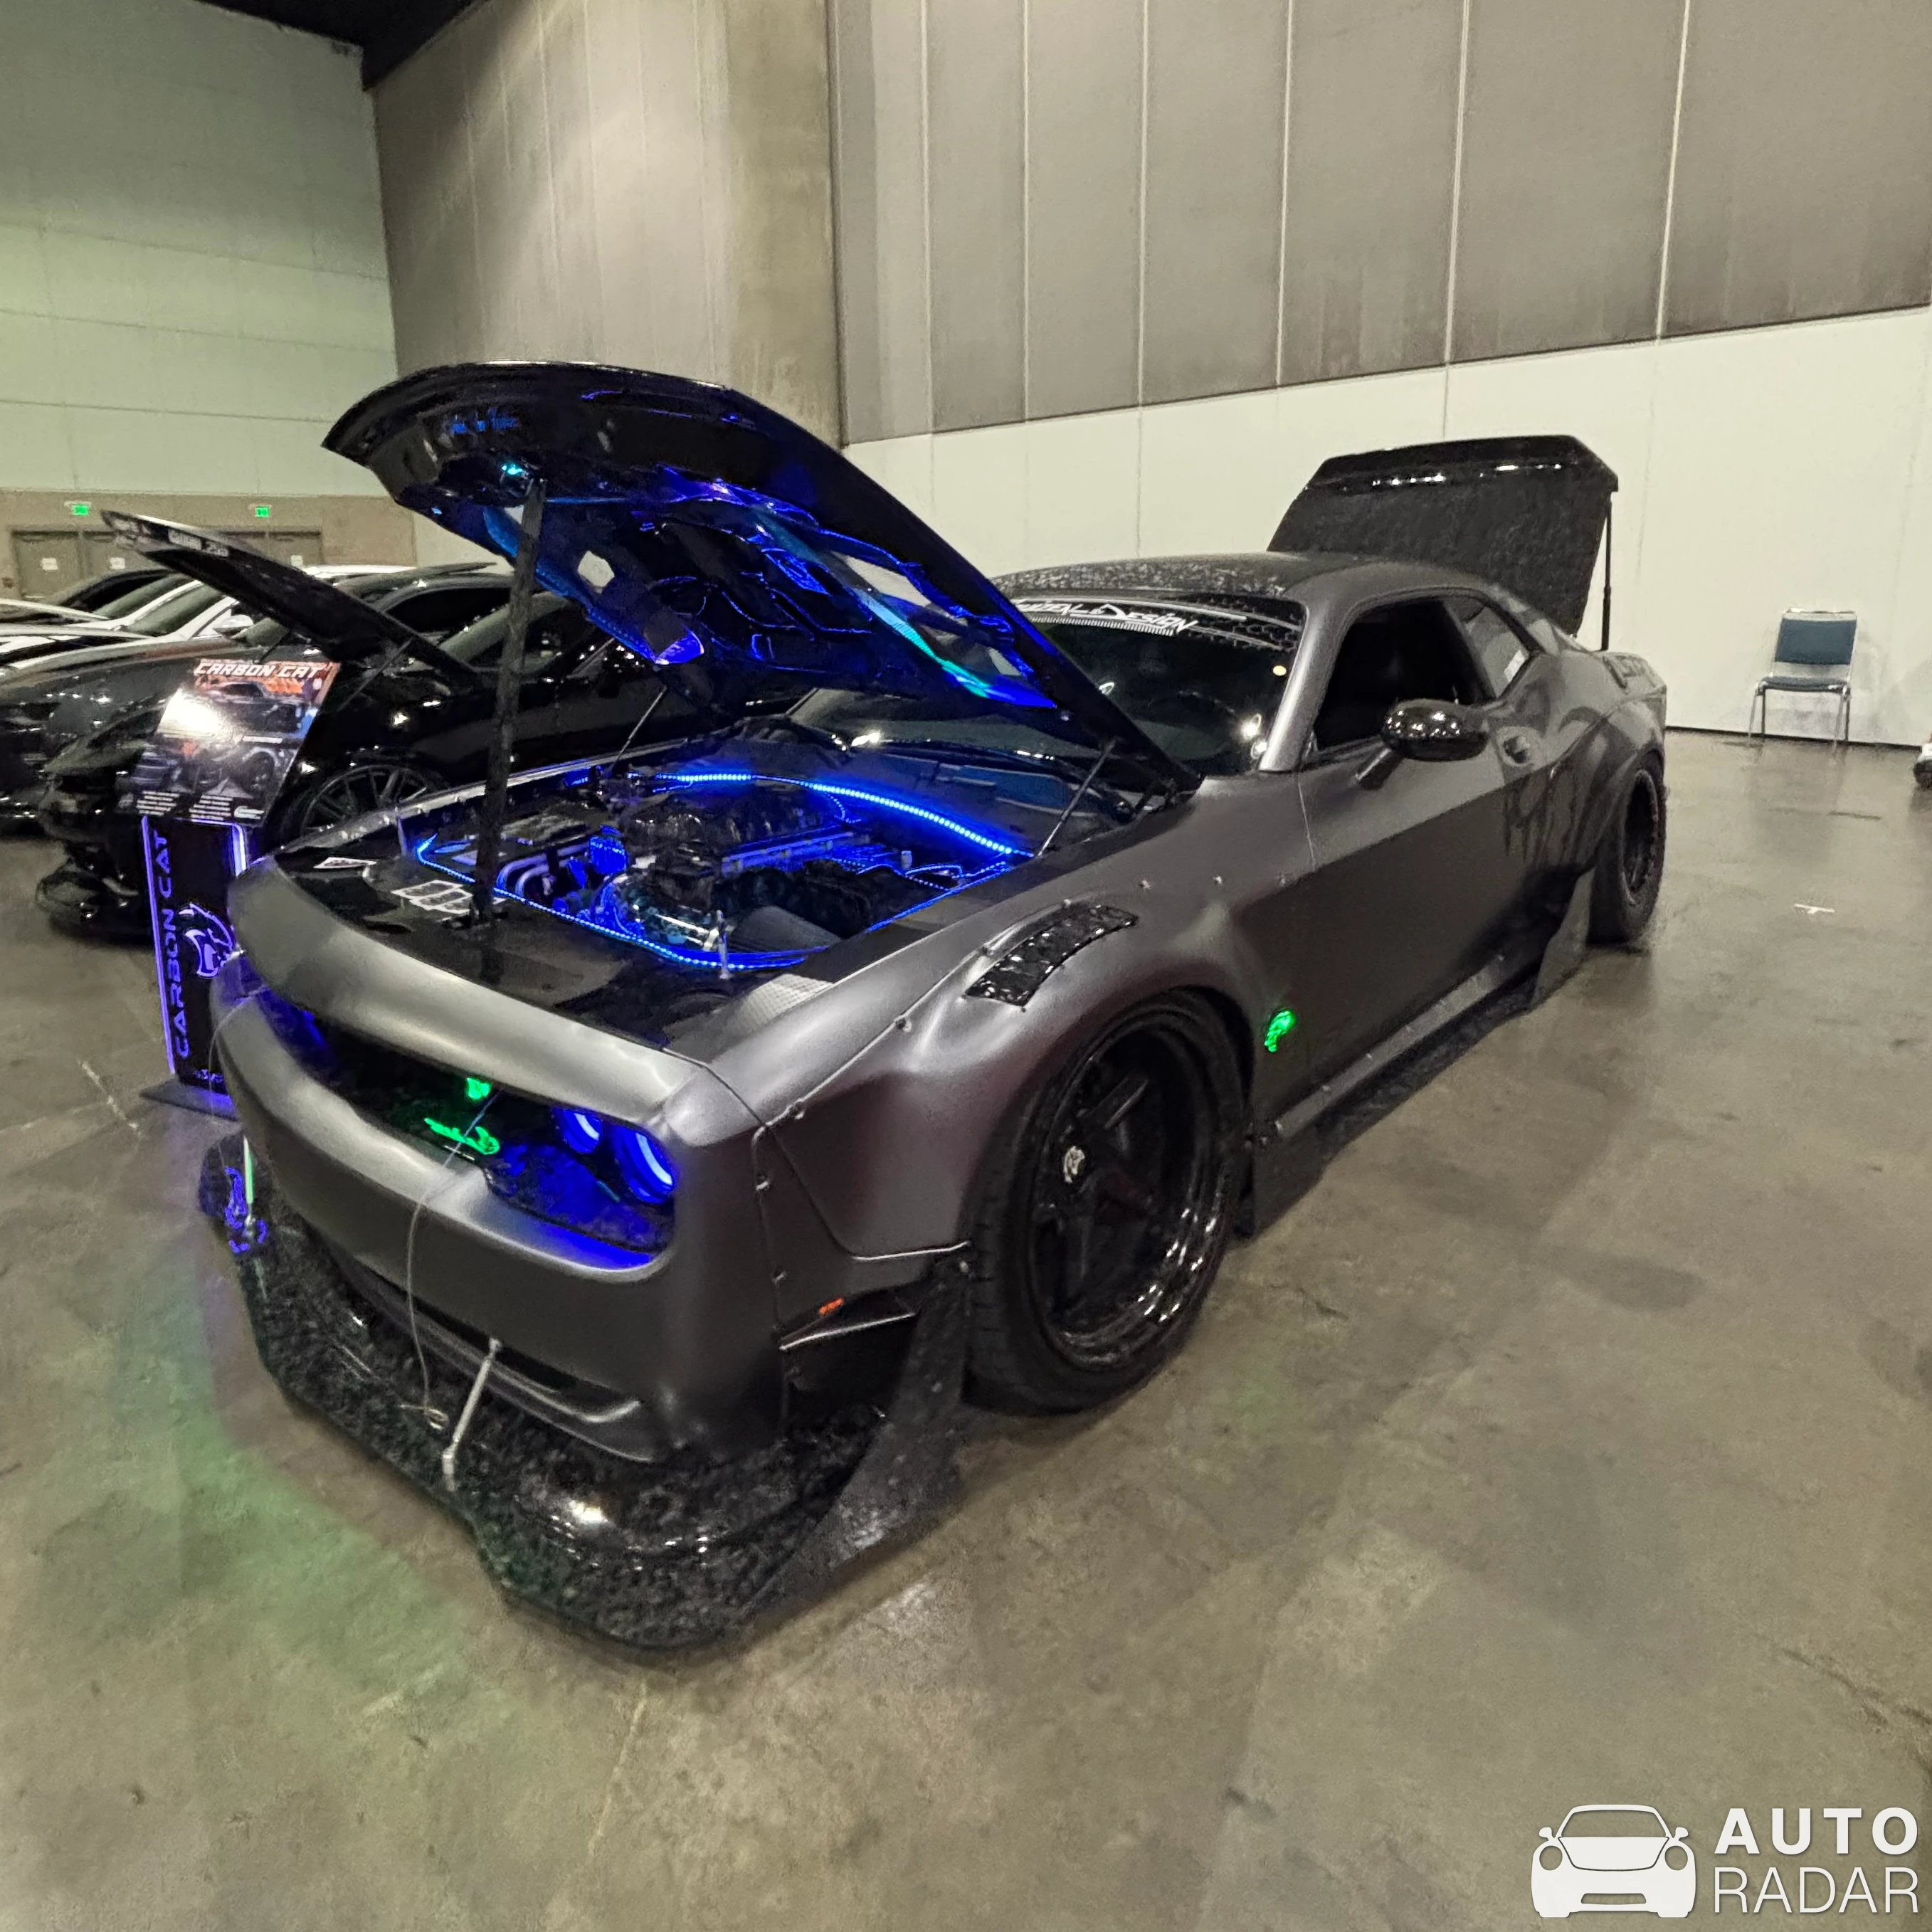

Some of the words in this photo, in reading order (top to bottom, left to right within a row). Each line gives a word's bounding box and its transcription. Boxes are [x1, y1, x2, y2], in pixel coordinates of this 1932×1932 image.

[194, 662, 276, 677] CARBON
[278, 665, 326, 678] CAT
[153, 829, 172, 899] CAT
[161, 908, 190, 1058] CARBON
